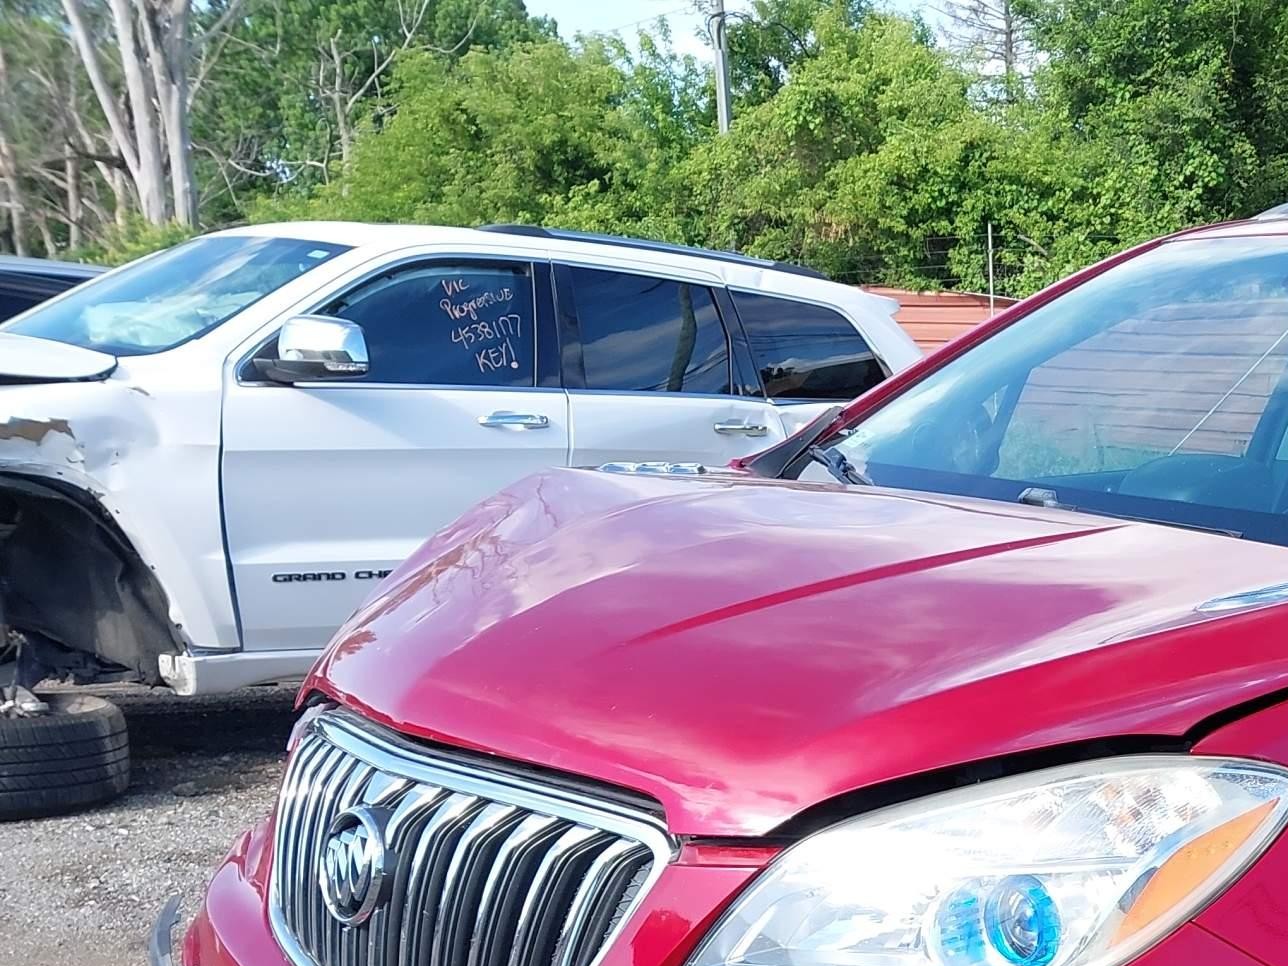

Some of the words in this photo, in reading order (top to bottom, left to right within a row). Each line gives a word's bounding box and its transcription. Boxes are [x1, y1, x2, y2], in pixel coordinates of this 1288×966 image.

[451, 314, 521, 350] 4538177
[475, 337, 519, 373] KEY!
[272, 572, 347, 583] GRAND
